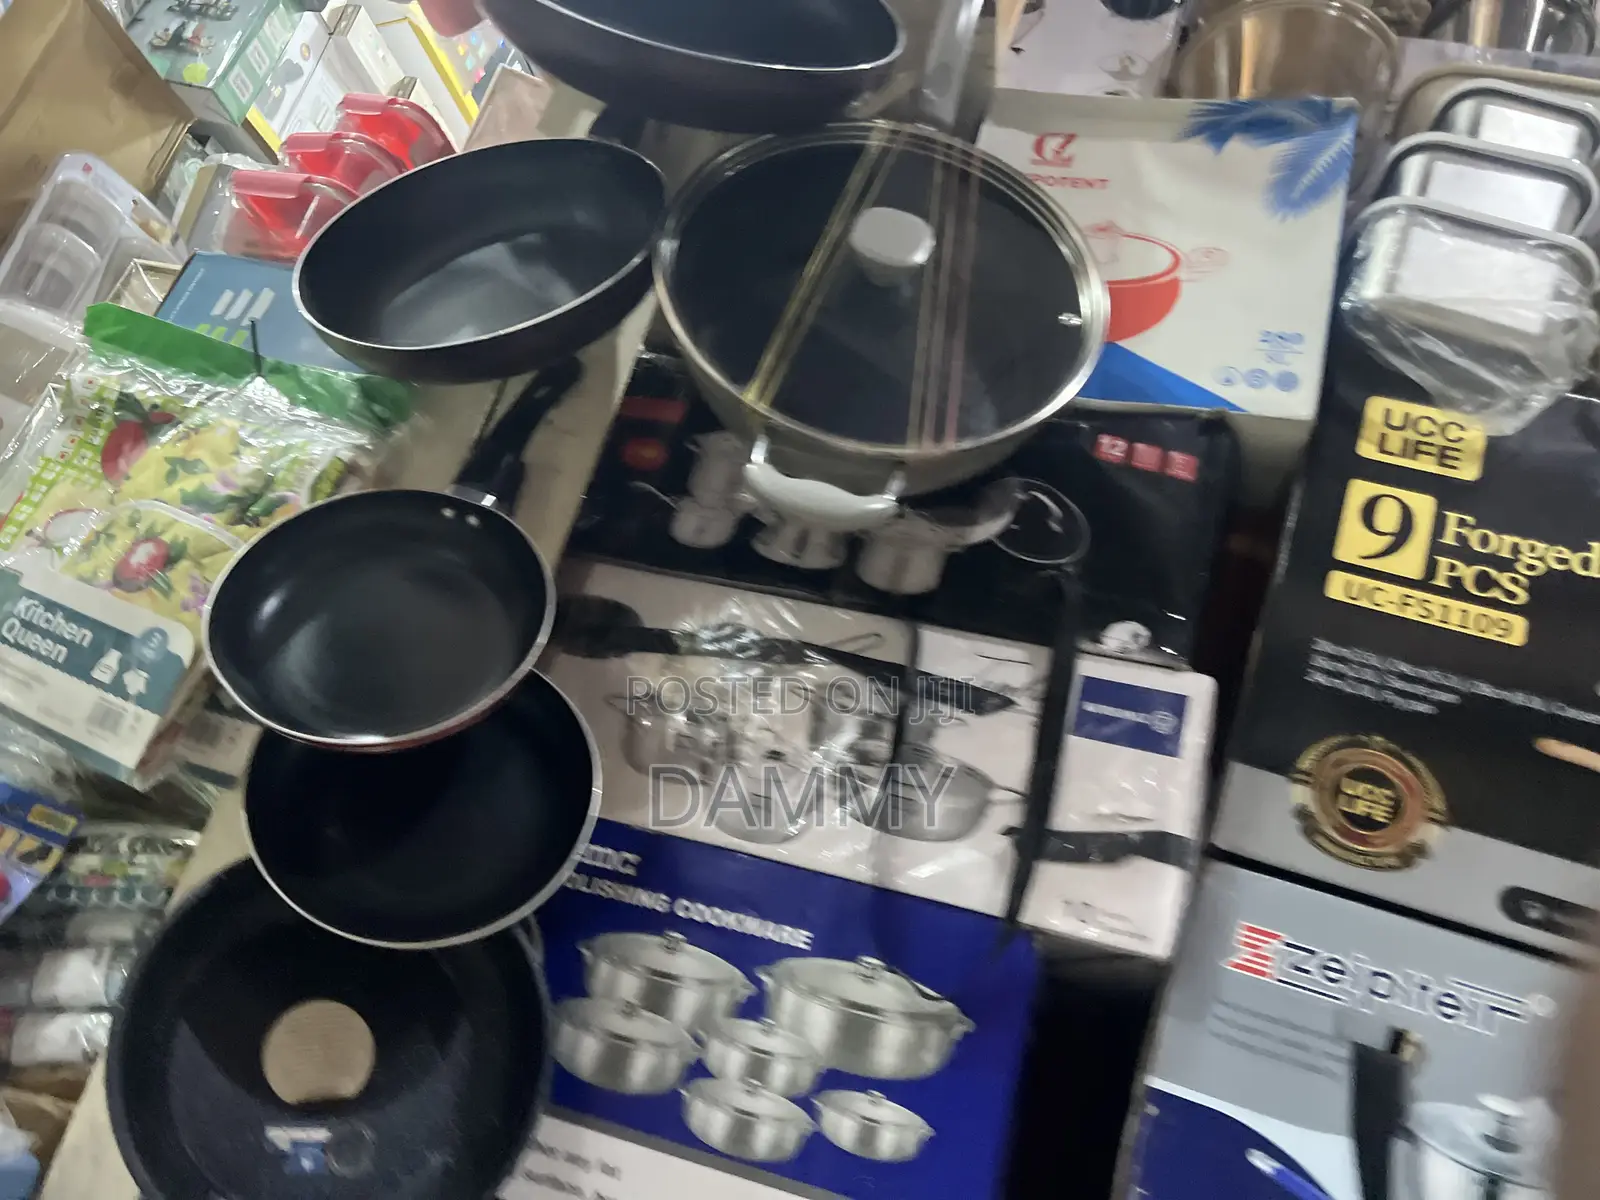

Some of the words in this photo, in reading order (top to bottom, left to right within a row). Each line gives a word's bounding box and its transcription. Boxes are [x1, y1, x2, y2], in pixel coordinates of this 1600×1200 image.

[1384, 408, 1467, 443] UCC
[1378, 433, 1462, 470] LIFE
[1360, 493, 1414, 560] 9
[1438, 510, 1600, 579] Forged
[1429, 555, 1531, 605] PCS
[13, 596, 94, 648] Kitchen
[1342, 580, 1514, 638] UC-FS1109
[1, 617, 69, 664] Queen
